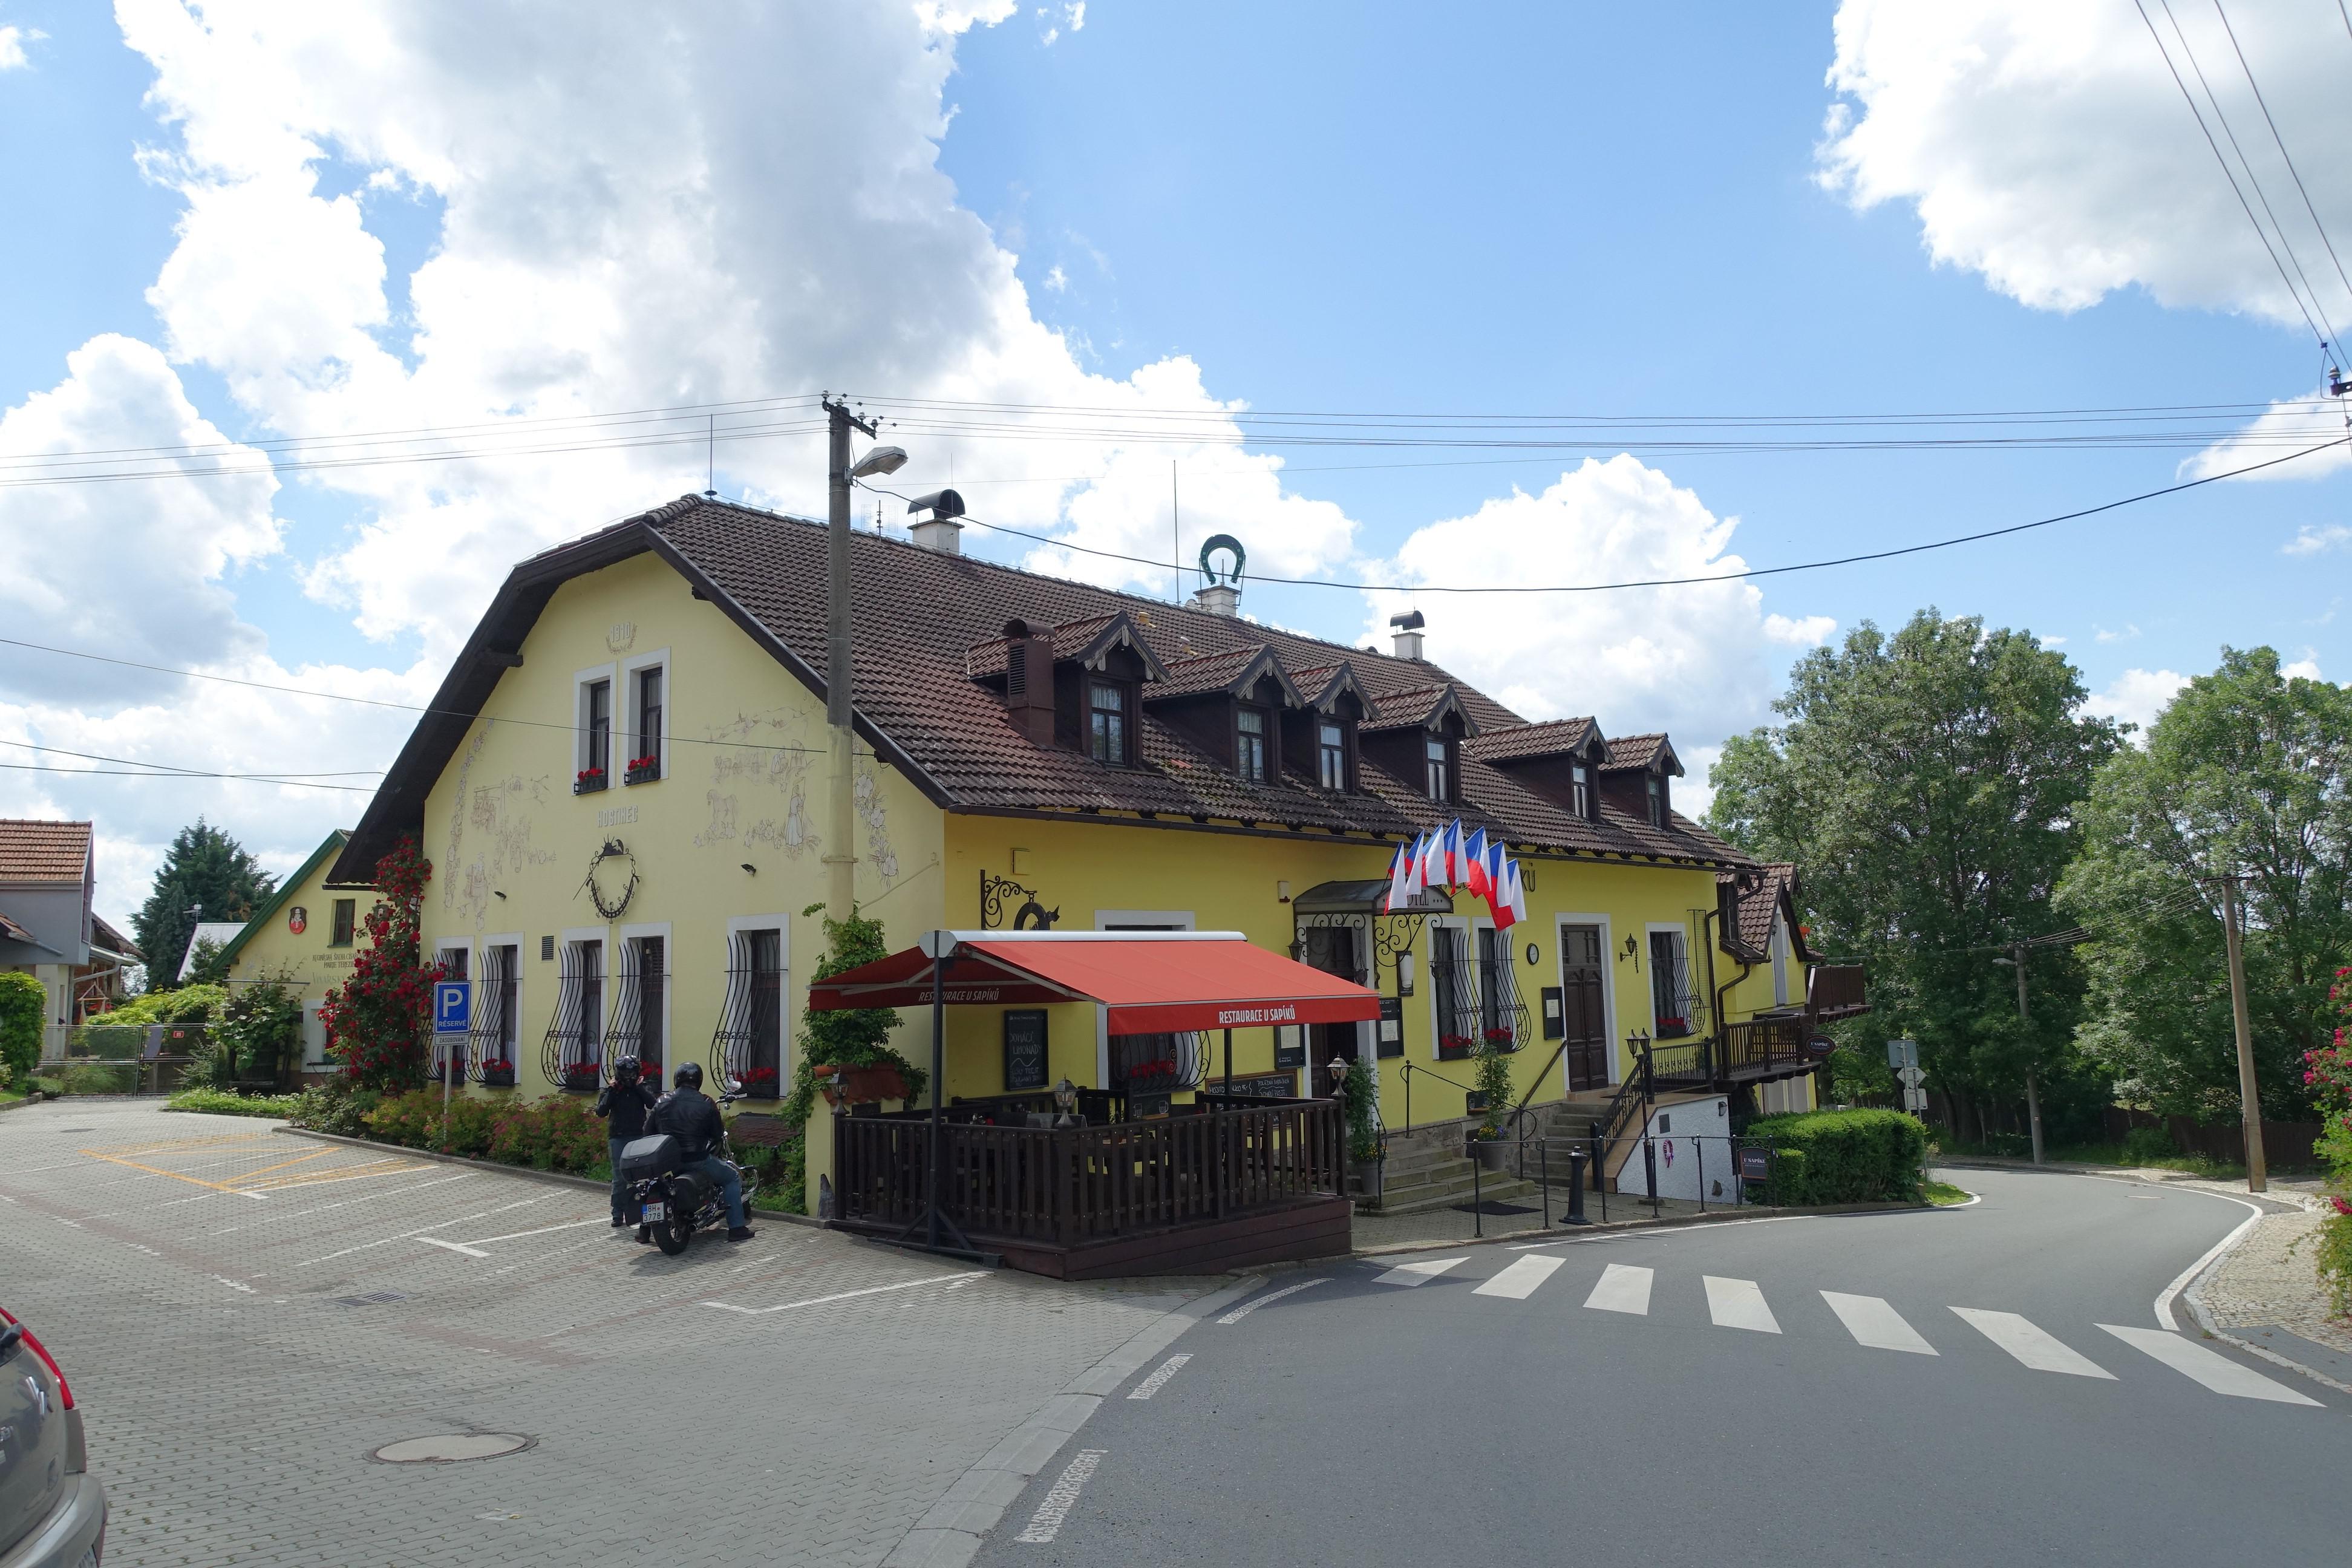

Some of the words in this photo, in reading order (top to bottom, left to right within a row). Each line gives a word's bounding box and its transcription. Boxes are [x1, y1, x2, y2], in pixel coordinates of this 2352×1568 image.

[1407, 890, 1428, 906] OTEL
[918, 991, 966, 1001] RESTURACE
[967, 991, 972, 1001] U
[972, 987, 999, 1001] SAPÍKŮ
[443, 988, 463, 1017] P
[1219, 1009, 1263, 1024] RESTAURACE
[1264, 1009, 1269, 1021] U
[1270, 1004, 1295, 1021] SAPÍKŮ
[438, 1019, 466, 1027] RÉSERVÉ
[644, 1212, 661, 1221] 3778
